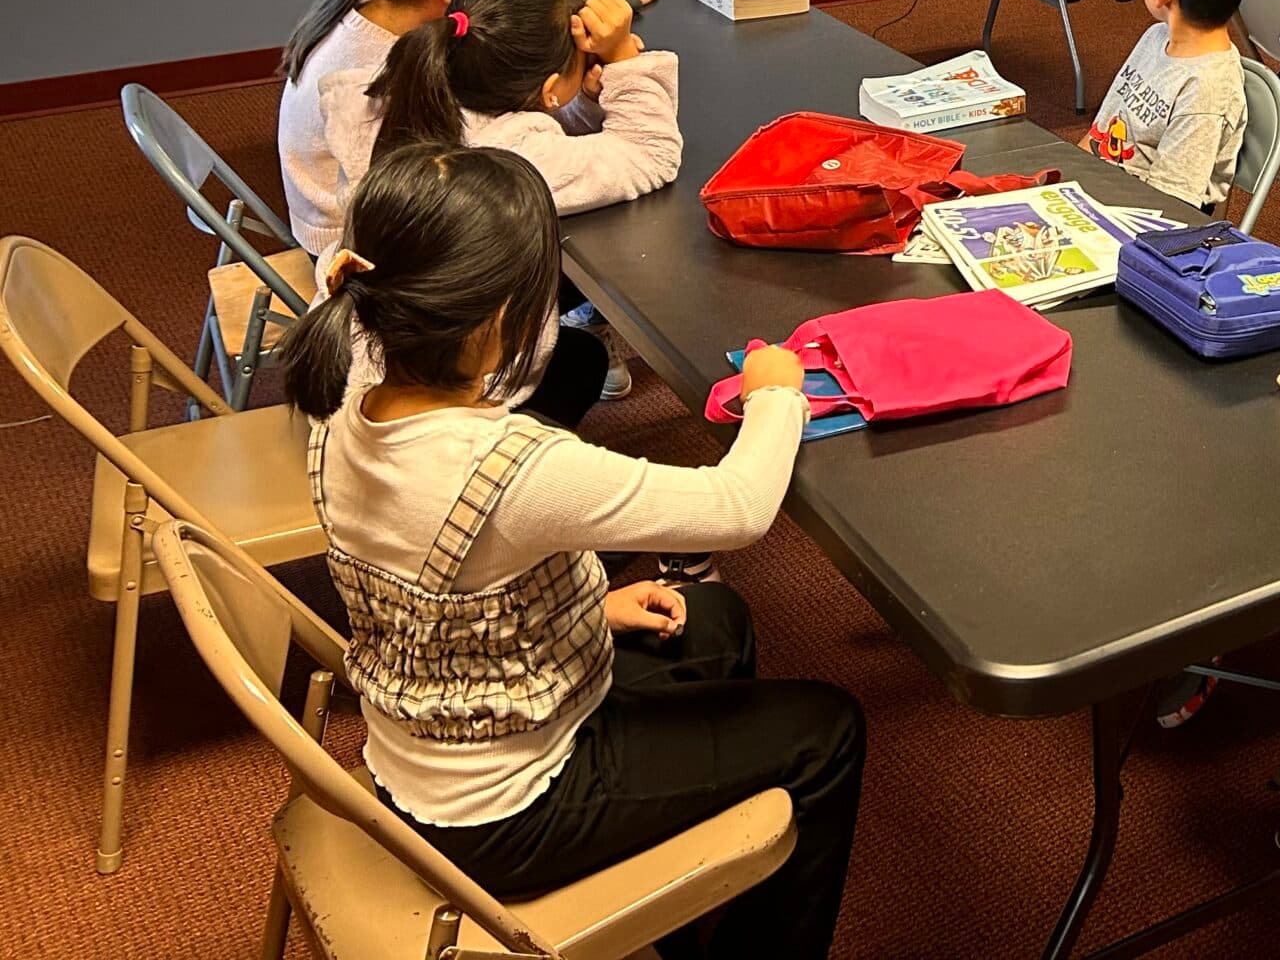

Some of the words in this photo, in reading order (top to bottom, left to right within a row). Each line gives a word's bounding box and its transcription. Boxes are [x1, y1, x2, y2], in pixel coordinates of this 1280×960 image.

[913, 117, 937, 129] HOLY
[937, 113, 961, 125] BIBLE
[968, 108, 987, 119] KIDS
[1138, 85, 1170, 119] RIDGE
[1040, 191, 1098, 234] engage
